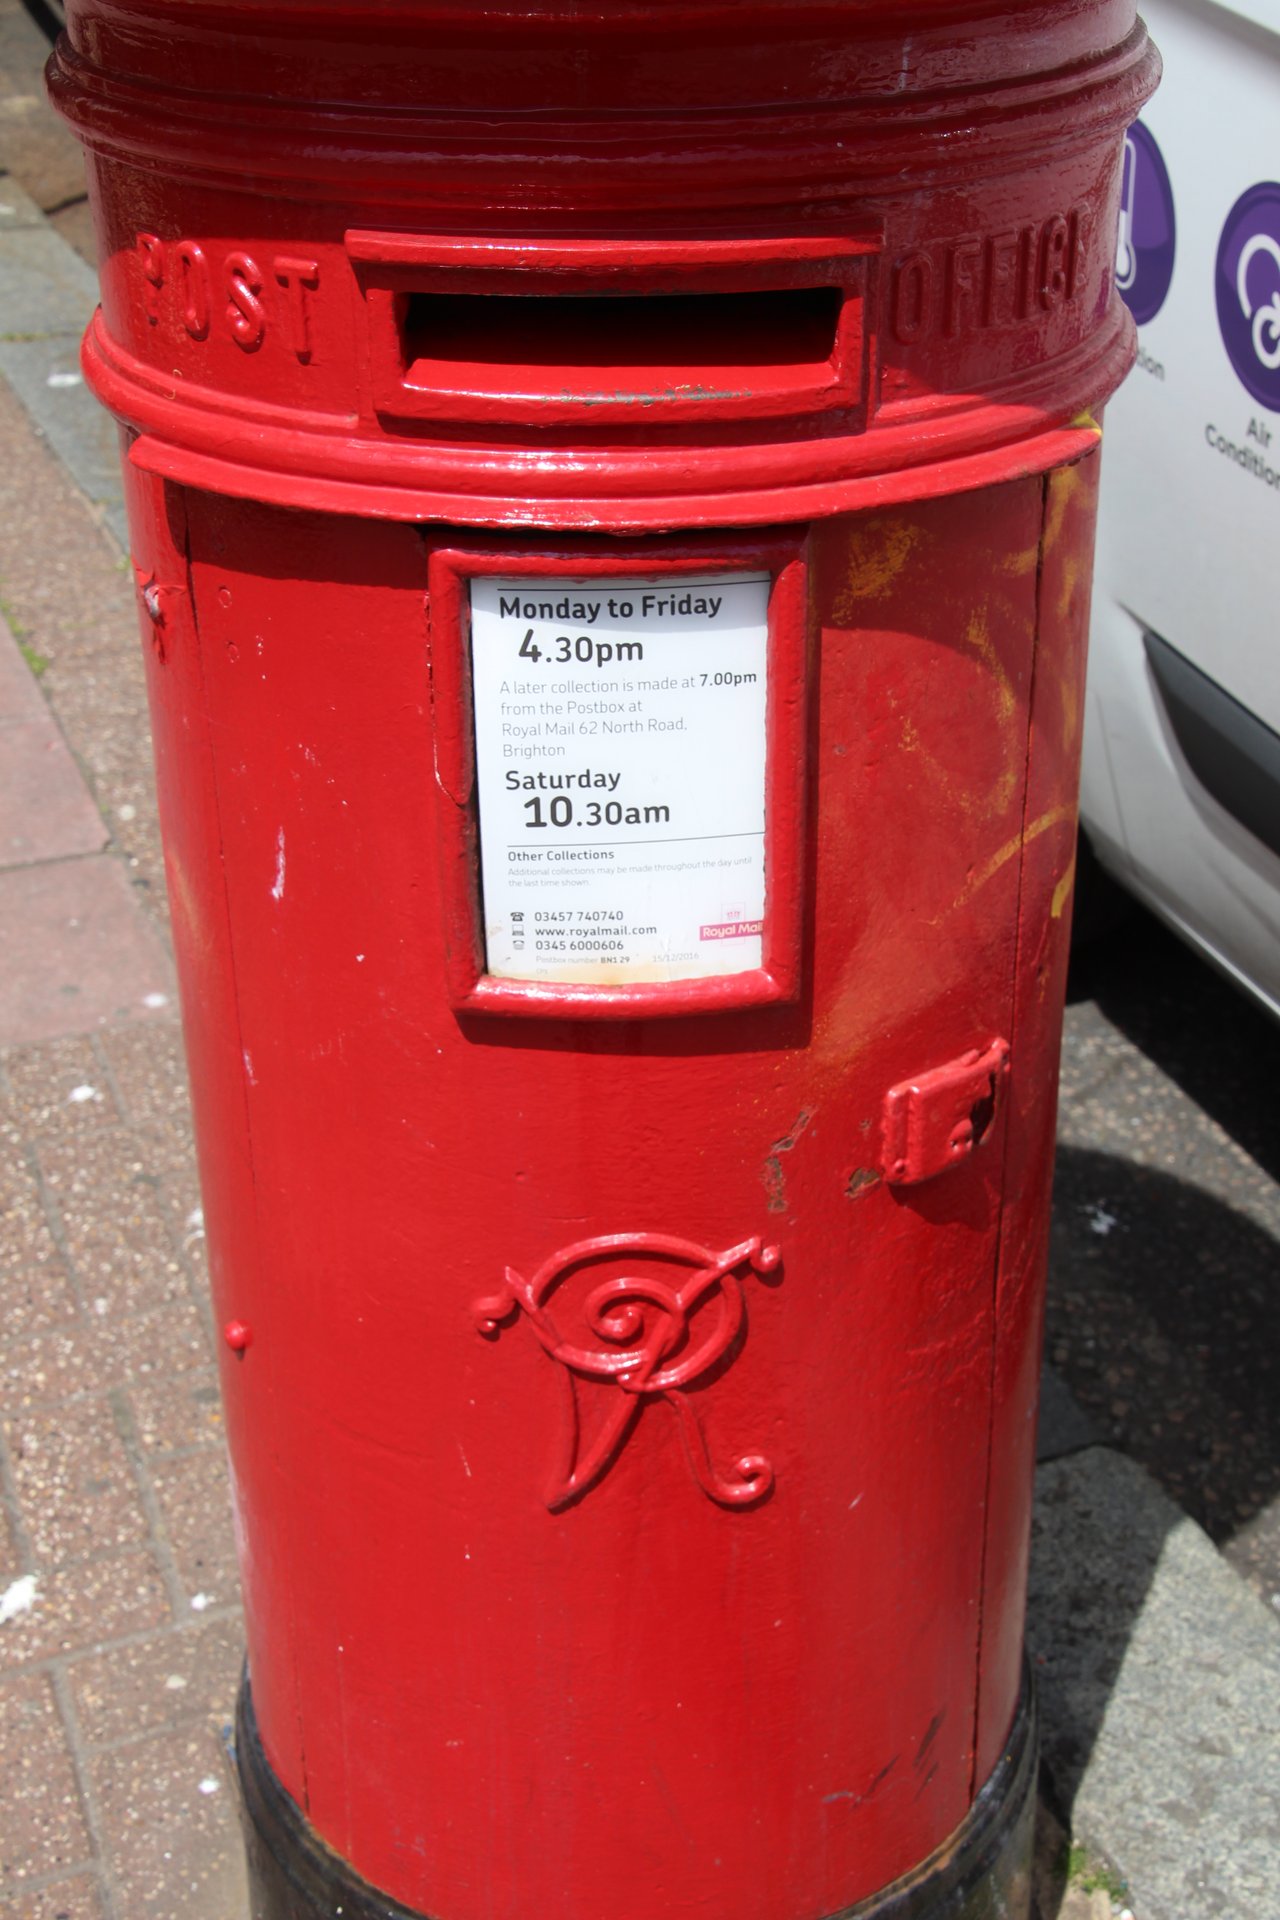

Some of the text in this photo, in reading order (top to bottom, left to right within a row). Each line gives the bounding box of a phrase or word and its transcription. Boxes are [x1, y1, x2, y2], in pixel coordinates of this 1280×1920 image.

[136, 232, 320, 366] POST
[1246, 416, 1272, 448] Air
[499, 594, 722, 623] Monday to Friday
[518, 628, 644, 668] 4.30pm
[500, 671, 757, 694] A later collection is made at 7.00pm
[501, 700, 643, 715] from the Postbox at
[502, 723, 541, 739] Royal
[545, 722, 575, 736] Mail
[579, 721, 598, 735] 62
[602, 719, 644, 734] North
[503, 743, 566, 760] Brighton
[505, 769, 621, 792] Saturday
[523, 795, 670, 829] 10.30am
[508, 850, 615, 861] Other Collections
[508, 856, 753, 876] Additional collections may be made throughout the day until
[508, 879, 523, 887] the
[523, 879, 539, 887] last
[540, 879, 560, 887] time
[534, 910, 624, 922] 03457 740740
[535, 925, 657, 938] www.royalmail.com
[702, 926, 736, 939] Royal
[536, 940, 624, 950] 0345 6000606
[536, 955, 566, 964] Postbox
[567, 955, 599, 964] number
[600, 956, 618, 965] BN1
[619, 956, 631, 964] 29
